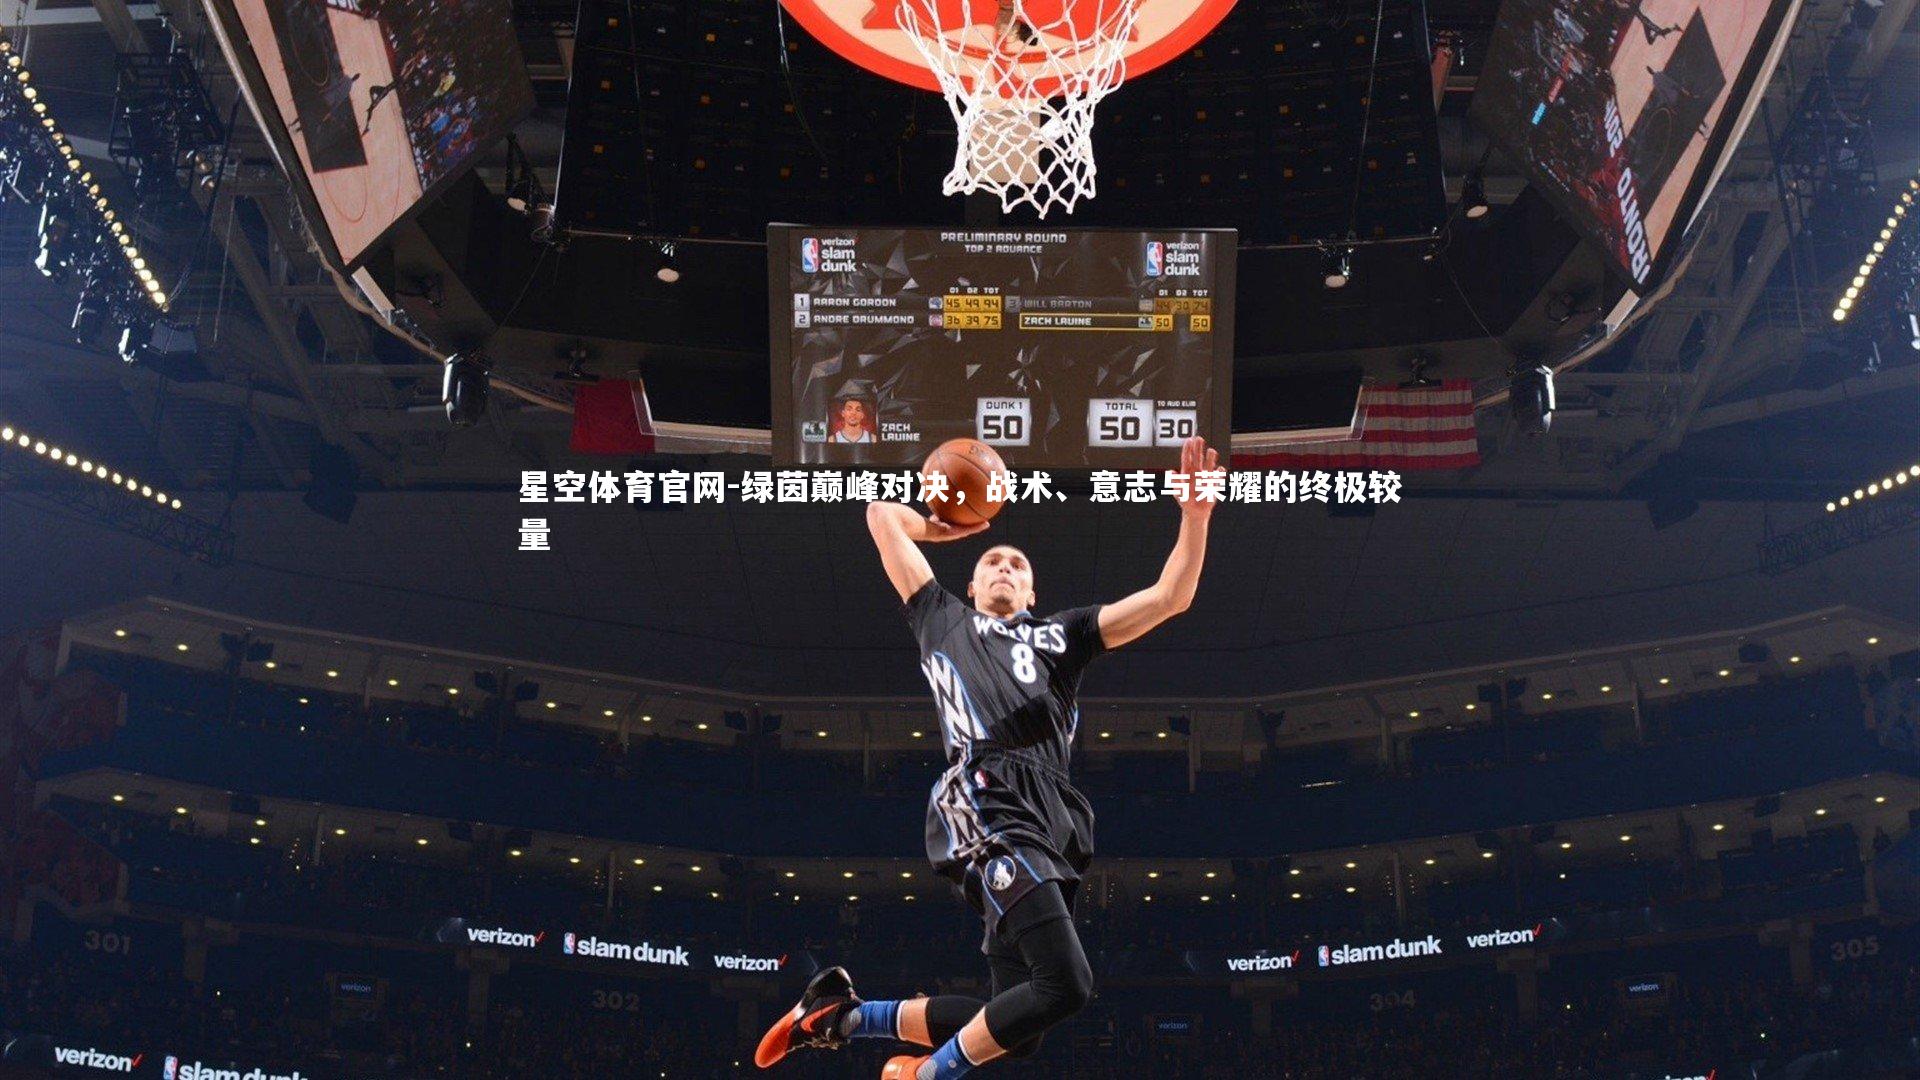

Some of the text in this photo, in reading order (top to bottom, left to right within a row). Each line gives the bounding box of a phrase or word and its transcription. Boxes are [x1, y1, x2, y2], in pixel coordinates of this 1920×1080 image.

[821, 237, 855, 246] verizon
[941, 232, 1067, 243] PRELIMINARY ROUND
[965, 245, 1042, 254] TOP 2 ADVANCE
[1166, 241, 1200, 250] verizon
[821, 246, 856, 260] slam
[1165, 250, 1200, 263] slam
[821, 259, 857, 272] dunk
[1165, 263, 1200, 276] dunk
[813, 298, 850, 307] AARON
[853, 298, 897, 307] GORDON
[946, 299, 960, 308] 45
[965, 299, 980, 308] 49
[983, 299, 999, 308] 94
[1024, 299, 1047, 309] WILL
[1050, 300, 1092, 309] BARTON
[799, 314, 807, 324] 2
[813, 315, 850, 324] ANDRE
[853, 315, 915, 324] DRUMMOND
[966, 315, 980, 325] 39
[984, 315, 999, 326] 75
[1024, 316, 1208, 328] ZACH LAVINE 50 50
[986, 401, 1015, 410] DUNK
[1106, 402, 1138, 411] TOTAL
[881, 423, 911, 432] ZACH
[983, 415, 1023, 440] 50
[1100, 416, 1141, 441] 50
[1159, 418, 1193, 438] 30
[881, 432, 921, 441] LAVINE
[1011, 643, 1037, 684] 8
[84, 929, 131, 955] 301
[467, 927, 535, 948] verizon
[1466, 929, 1533, 948] verizon
[577, 937, 689, 966] slam dunk
[1331, 934, 1442, 965] slam dunk
[714, 954, 778, 971] verizon
[1227, 956, 1291, 972] verizon
[54, 1046, 131, 1072] verizon
